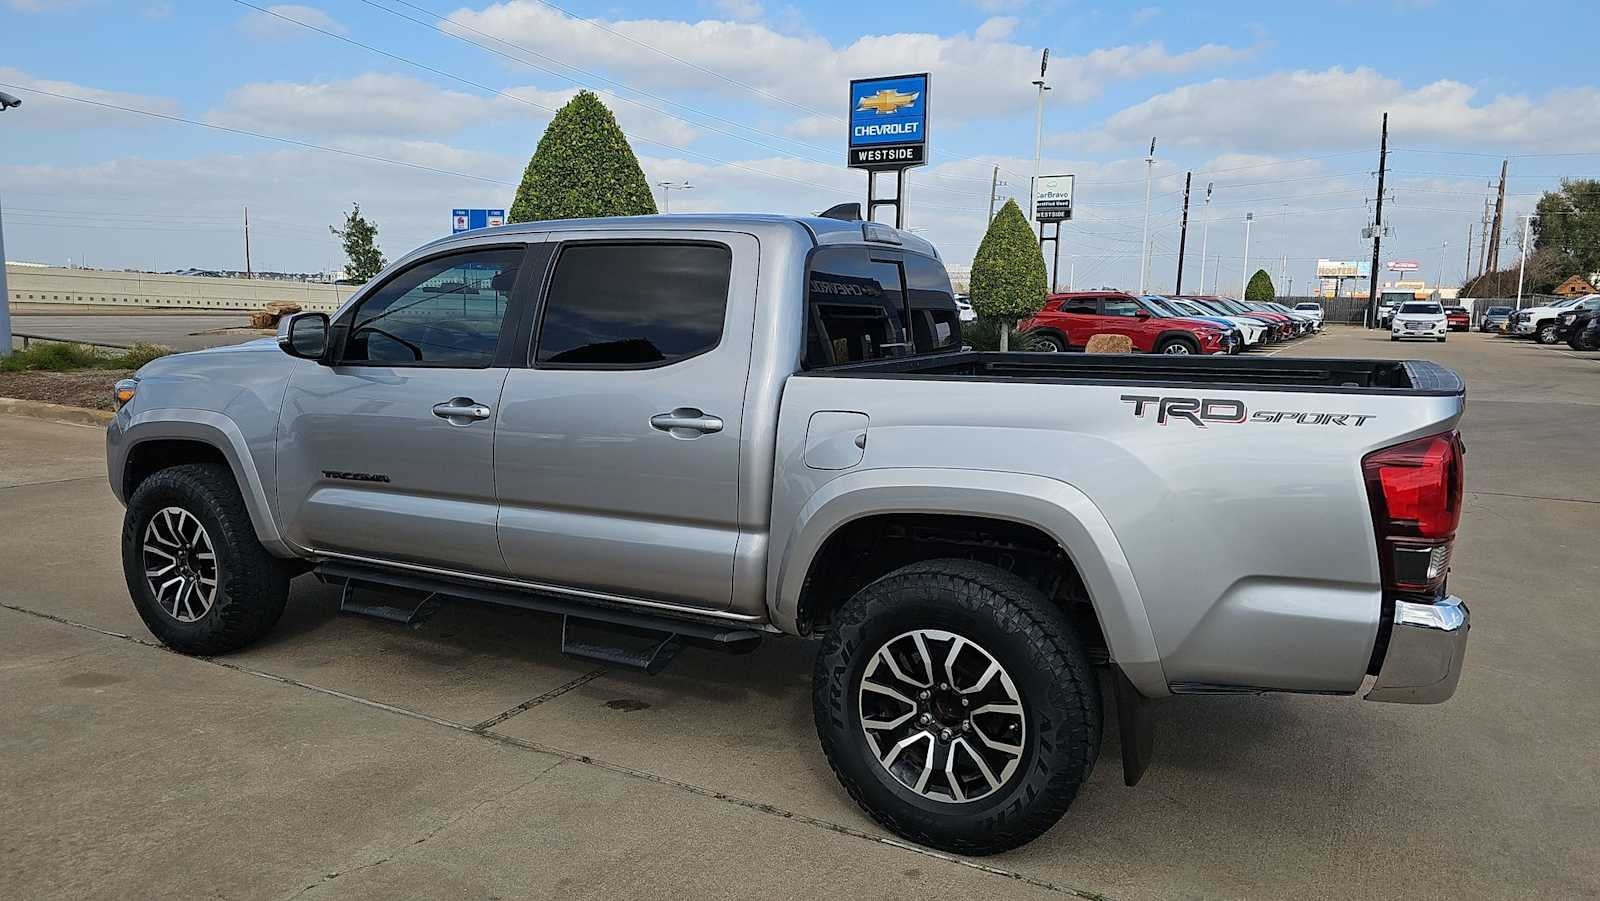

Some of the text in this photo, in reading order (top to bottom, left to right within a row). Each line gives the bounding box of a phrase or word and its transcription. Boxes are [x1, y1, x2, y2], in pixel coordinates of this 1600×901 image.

[854, 122, 919, 136] CHEVROLET
[859, 148, 913, 160] WESTSIDE
[1120, 394, 1377, 428] TRD SPORT
[321, 470, 390, 483] TACOMA
